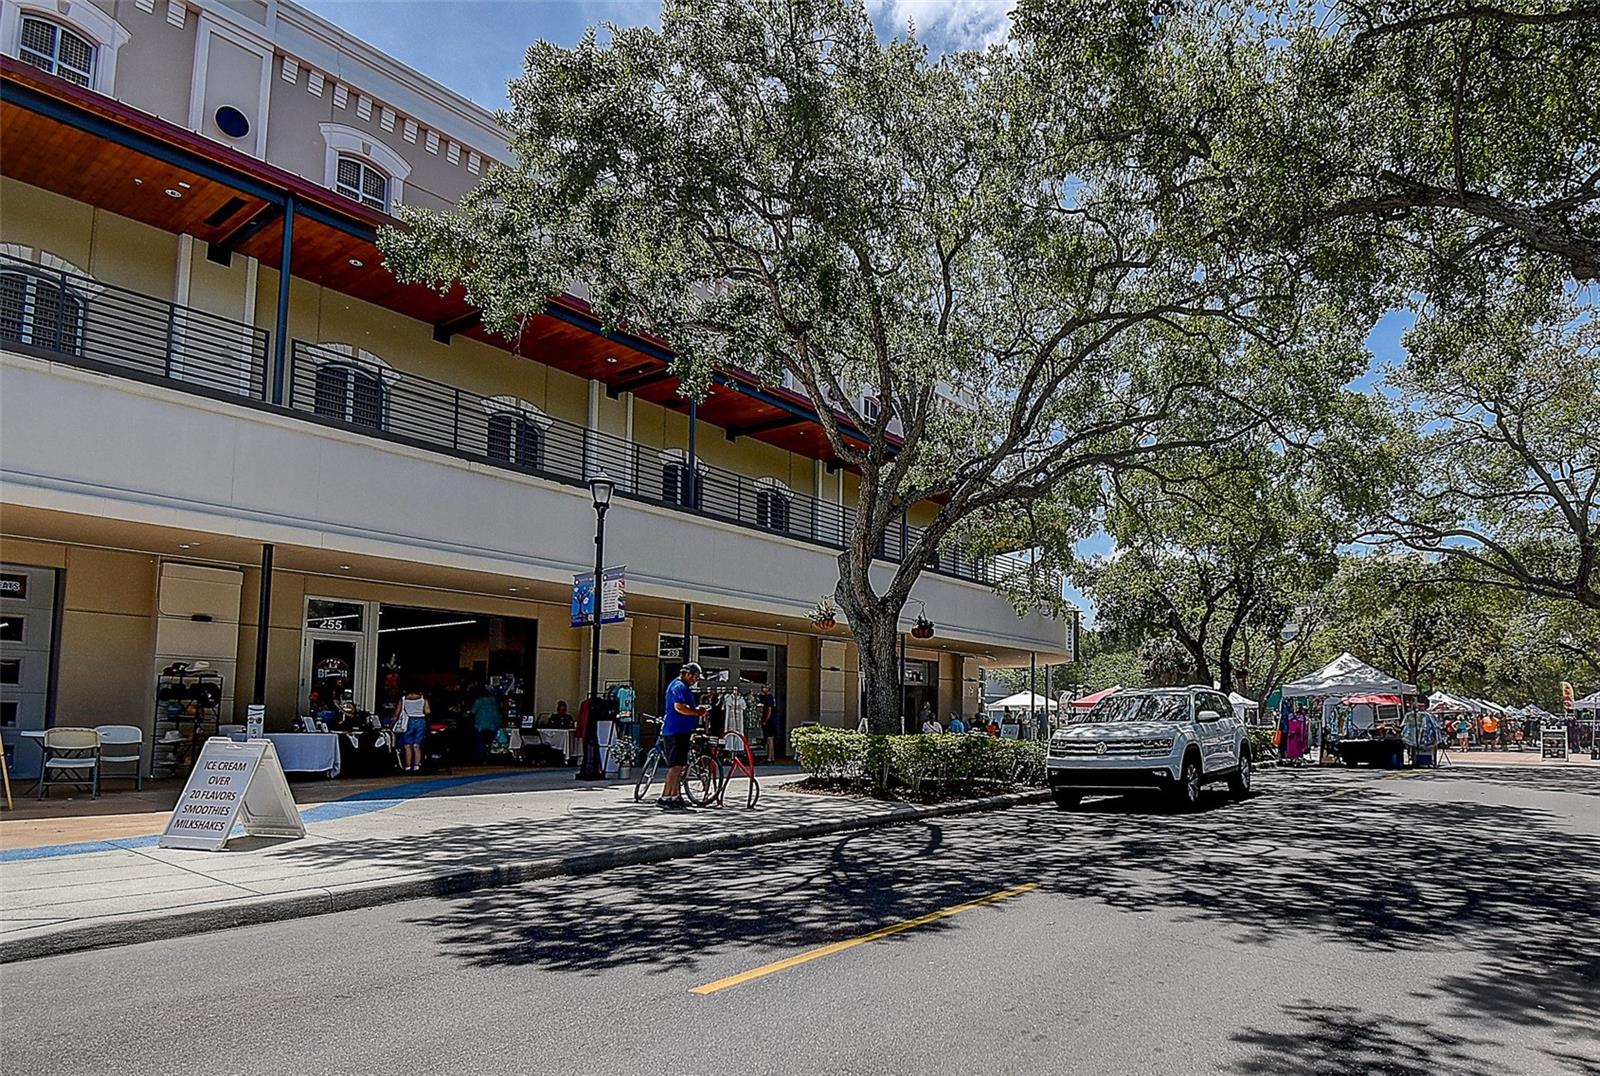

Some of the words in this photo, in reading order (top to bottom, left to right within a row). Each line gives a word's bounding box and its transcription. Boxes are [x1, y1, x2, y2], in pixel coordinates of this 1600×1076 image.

[320, 619, 342, 630] 255
[203, 761, 217, 770] ICE
[217, 761, 247, 772] CREAM
[208, 775, 231, 786] OVER
[189, 789, 201, 800] 20
[201, 790, 237, 801] FLAVORS
[182, 804, 231, 816] SMOOTHIES
[173, 819, 226, 832] MILKSHAKES
